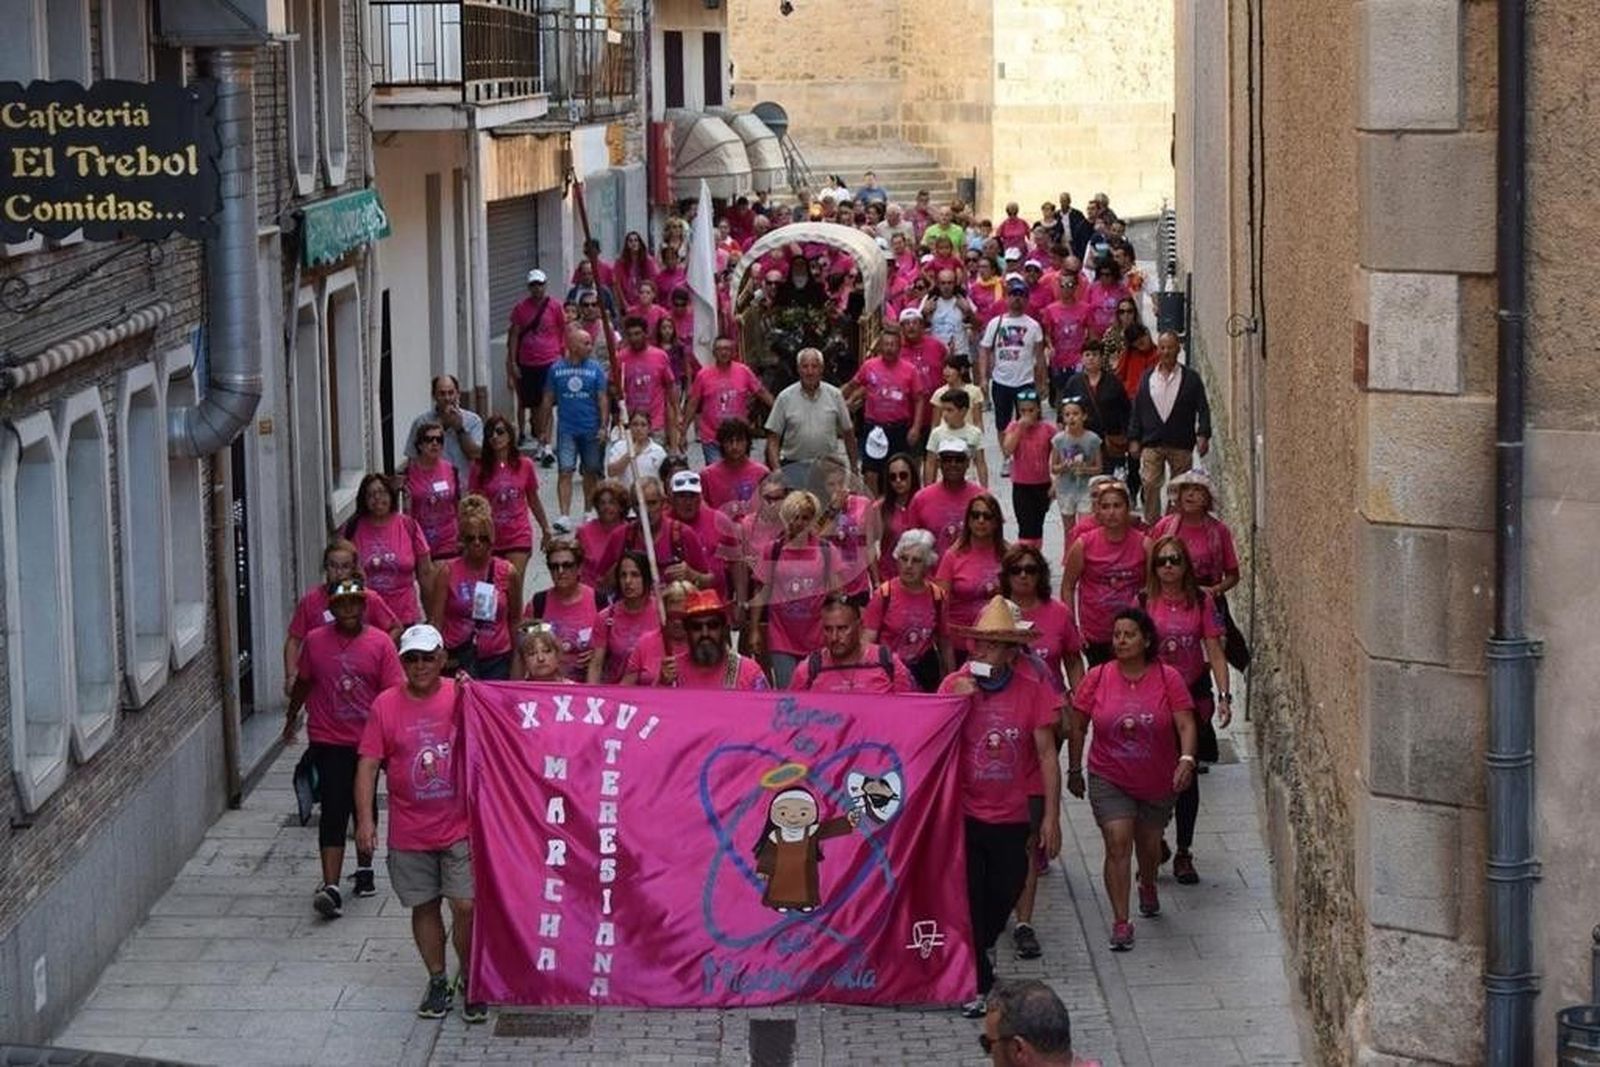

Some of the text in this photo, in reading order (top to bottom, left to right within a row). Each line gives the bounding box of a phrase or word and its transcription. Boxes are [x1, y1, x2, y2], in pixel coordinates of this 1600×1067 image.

[4, 194, 185, 221] Comidas...
[12, 144, 199, 177] El Trebol
[536, 755, 568, 971] MARCHA
[589, 739, 622, 997] TERESIANA
